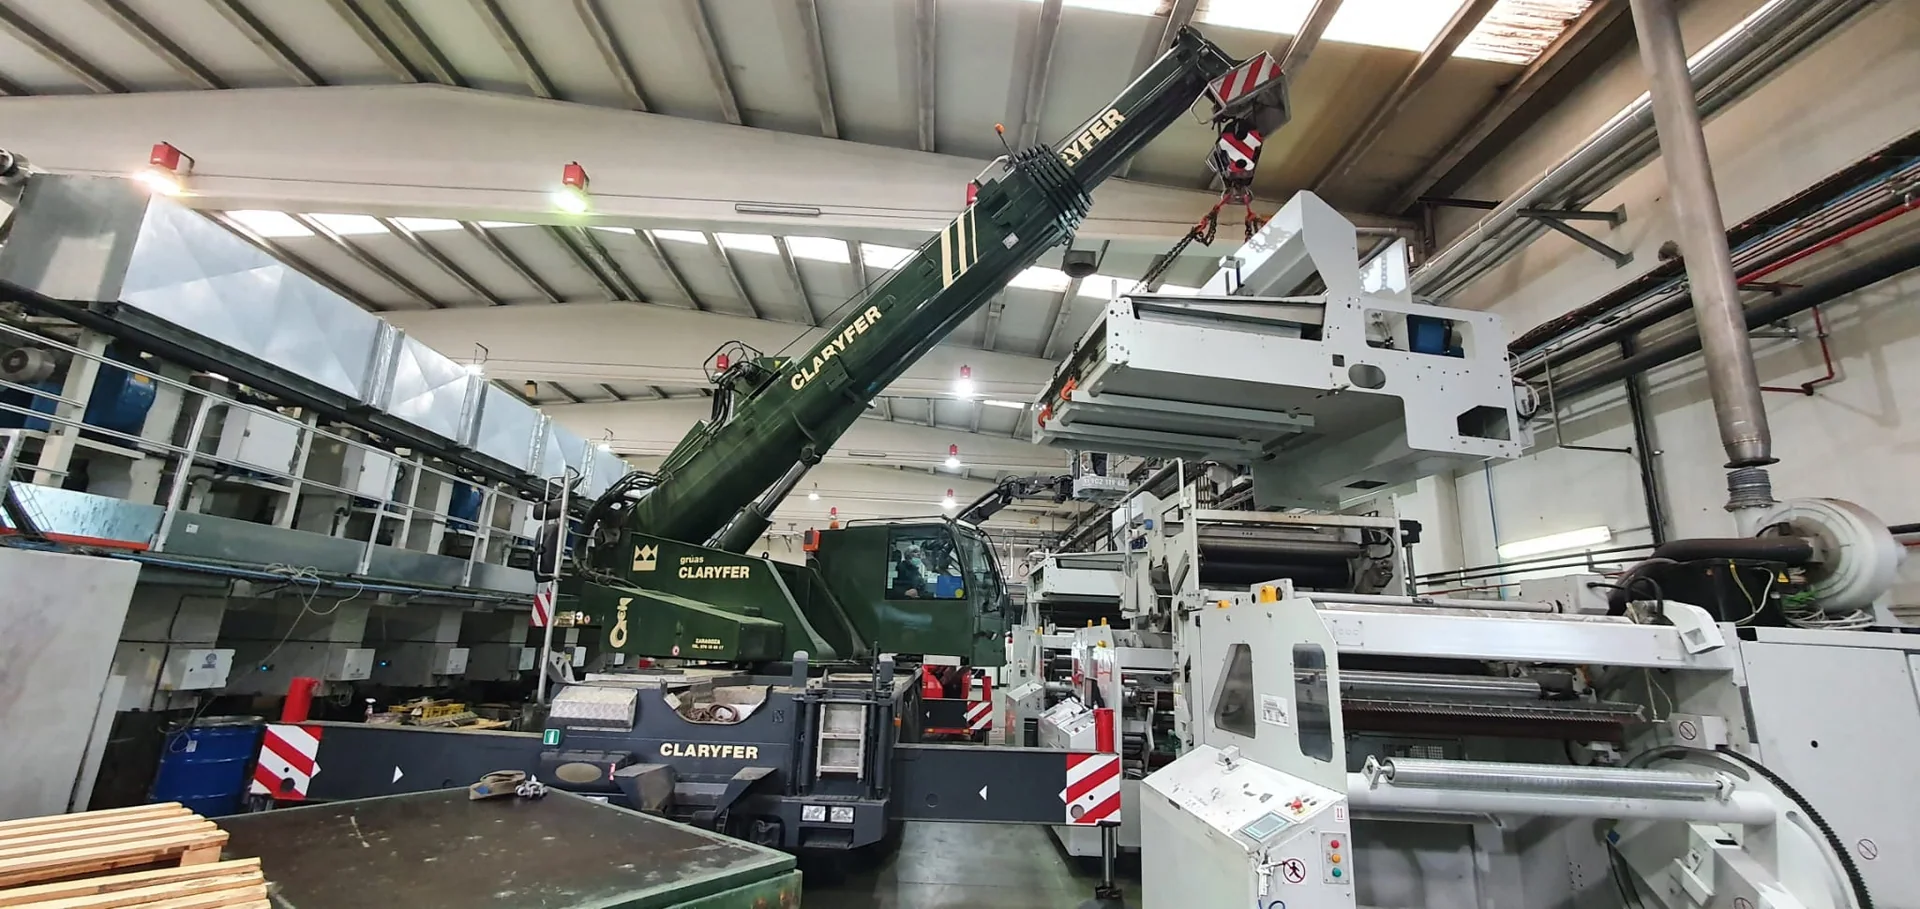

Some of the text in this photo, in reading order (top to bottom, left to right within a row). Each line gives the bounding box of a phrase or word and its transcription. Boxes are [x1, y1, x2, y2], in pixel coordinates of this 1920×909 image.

[791, 306, 882, 390] CLARYFER
[678, 566, 750, 579] CLARYFER
[660, 742, 758, 759] CLARYFER
